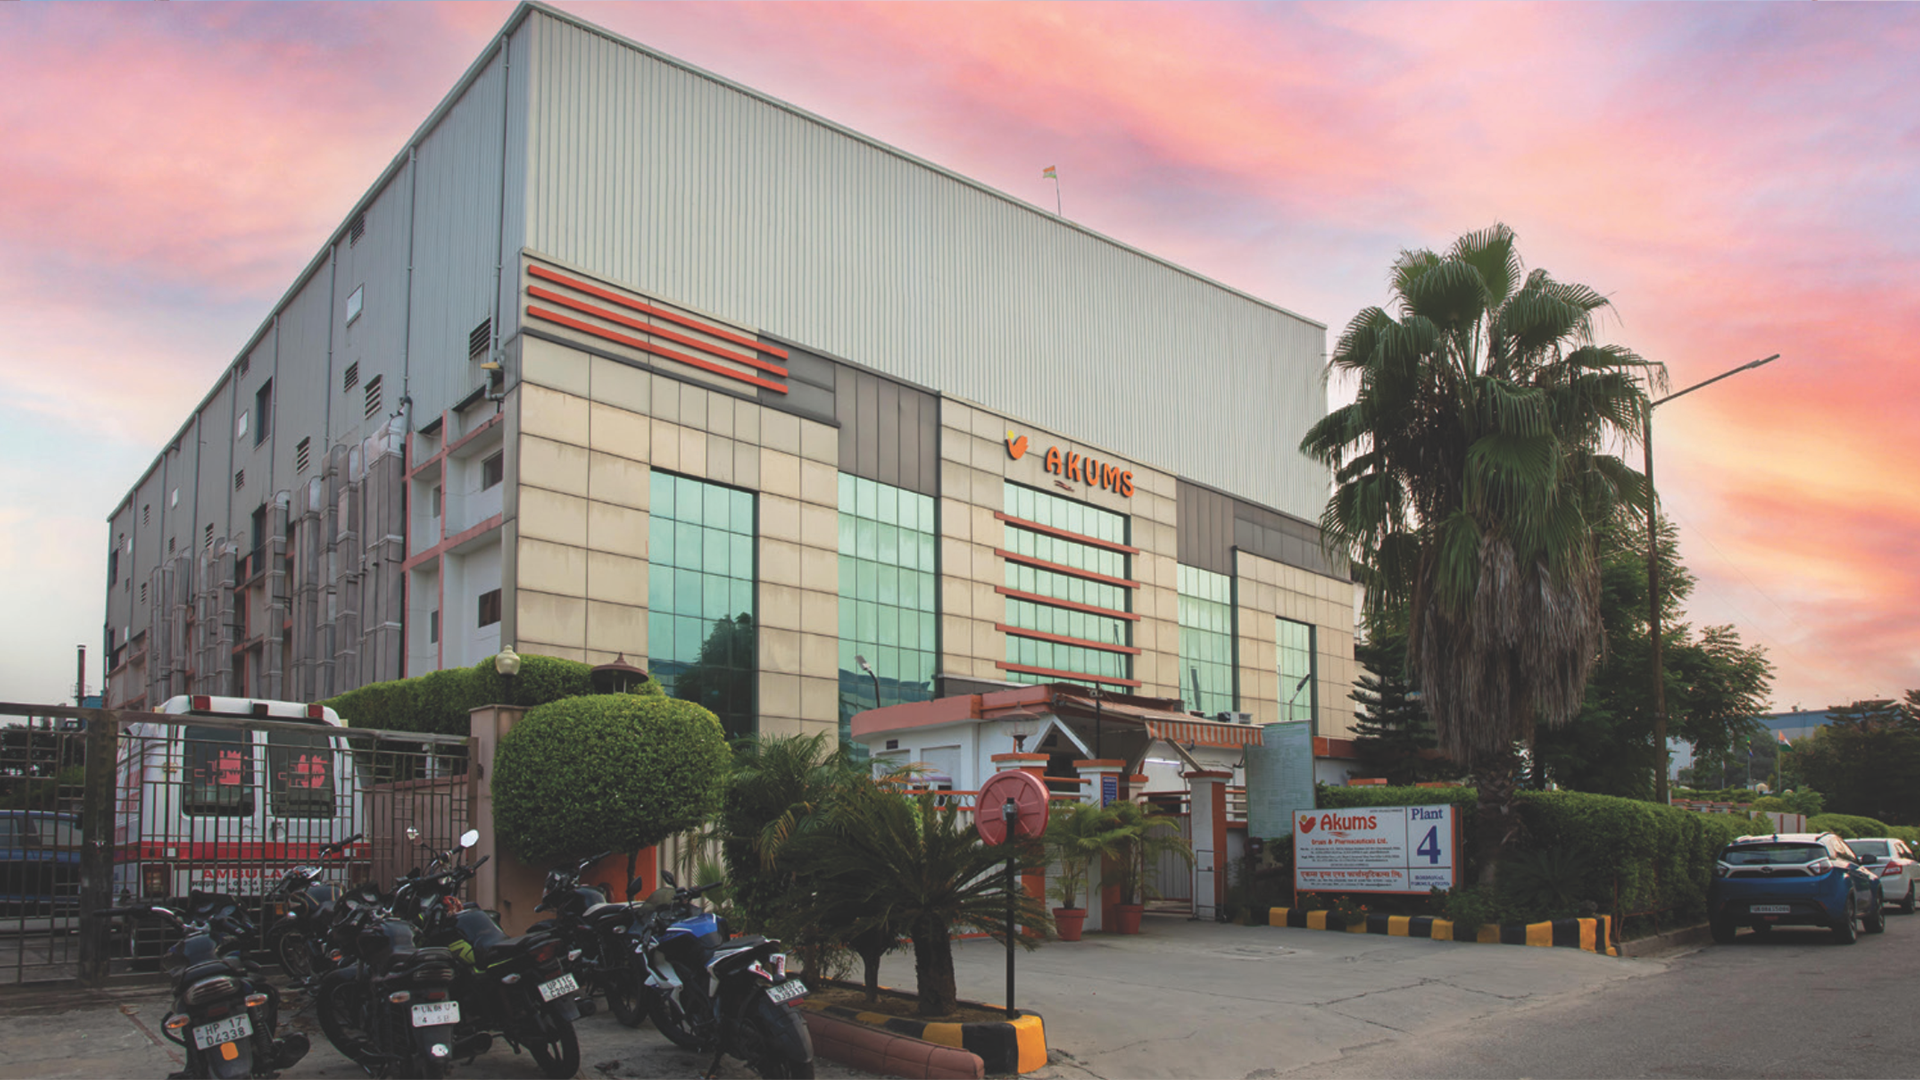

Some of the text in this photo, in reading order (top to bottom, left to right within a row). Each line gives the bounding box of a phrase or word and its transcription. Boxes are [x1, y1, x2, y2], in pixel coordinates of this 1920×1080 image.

[1045, 446, 1134, 498] AKUMS
[1321, 813, 1377, 830] Akums
[1411, 808, 1443, 820] Plant
[1416, 825, 1441, 864] 4
[205, 1016, 243, 1035] HP 17
